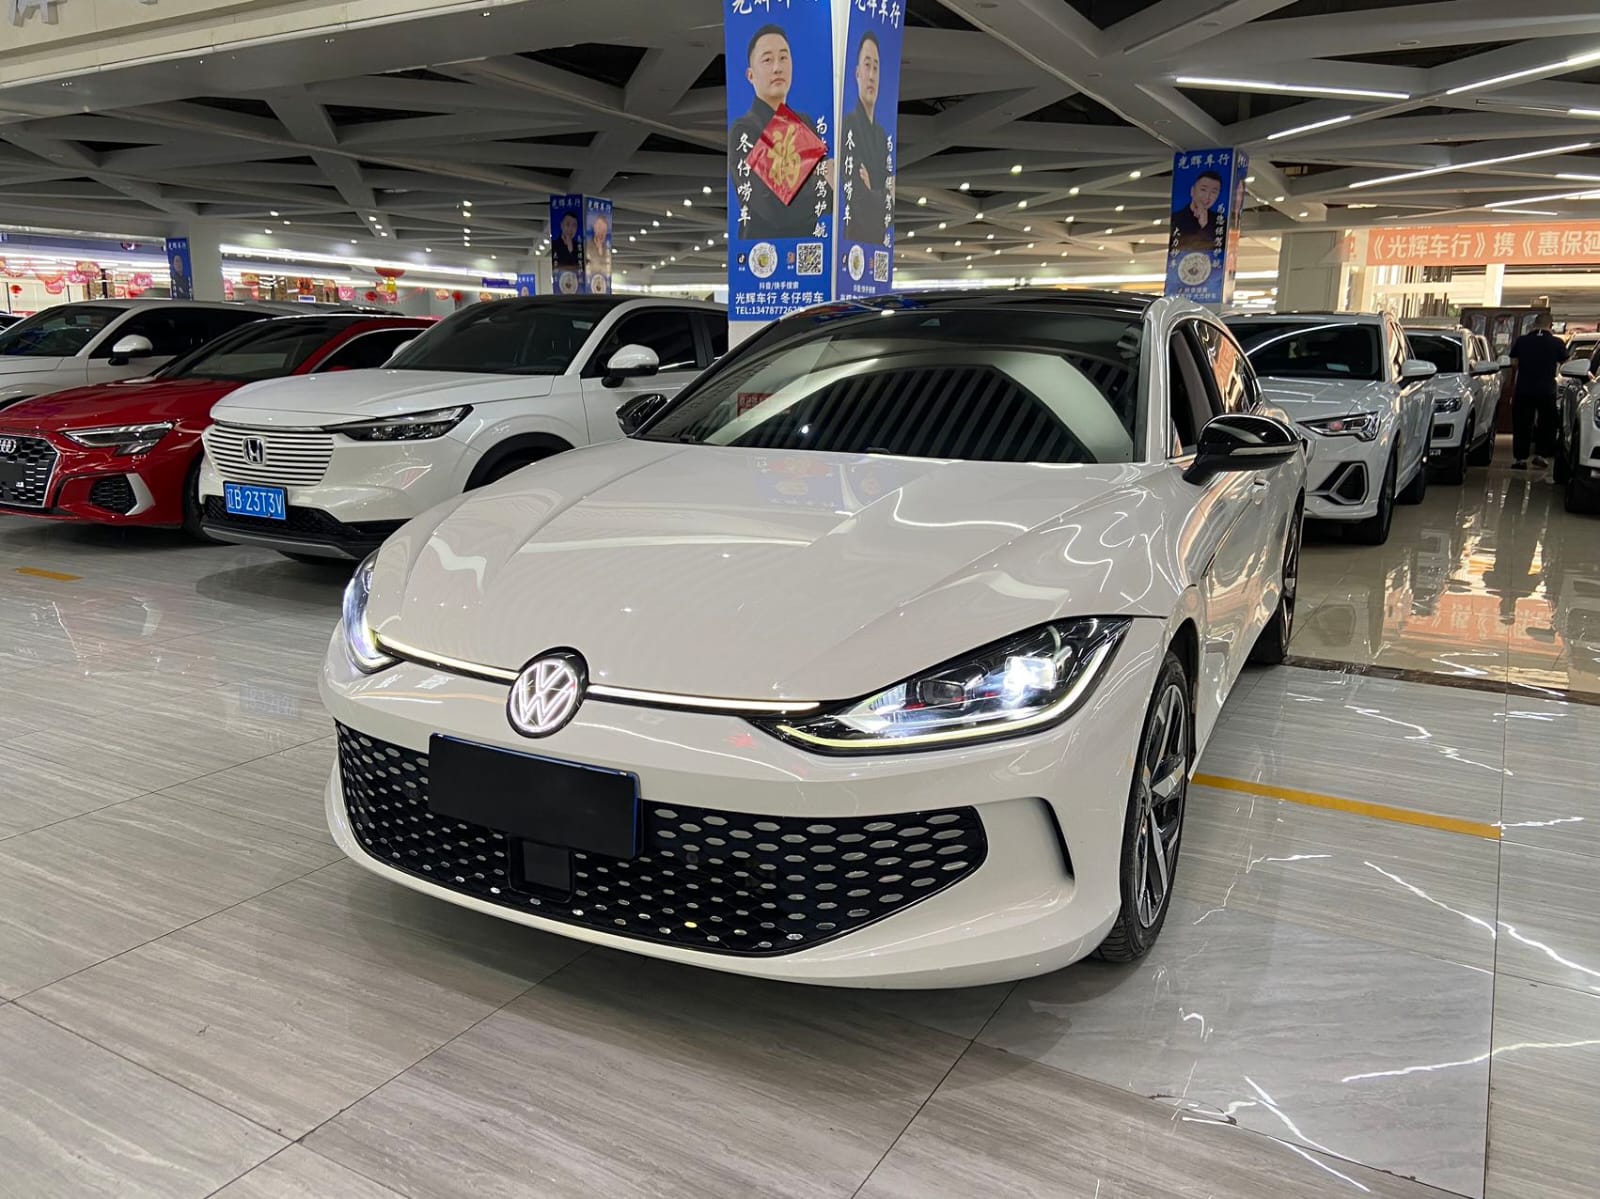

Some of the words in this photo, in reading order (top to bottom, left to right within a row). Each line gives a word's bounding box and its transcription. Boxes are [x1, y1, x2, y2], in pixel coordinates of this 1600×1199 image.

[766, 123, 802, 190] 福
[812, 115, 828, 238] 为保驾护航
[1178, 153, 1230, 169] 光辉车行
[736, 292, 777, 304] 光辉车行
[780, 291, 825, 304] 冬仔唠车
[510, 659, 577, 732] VW
